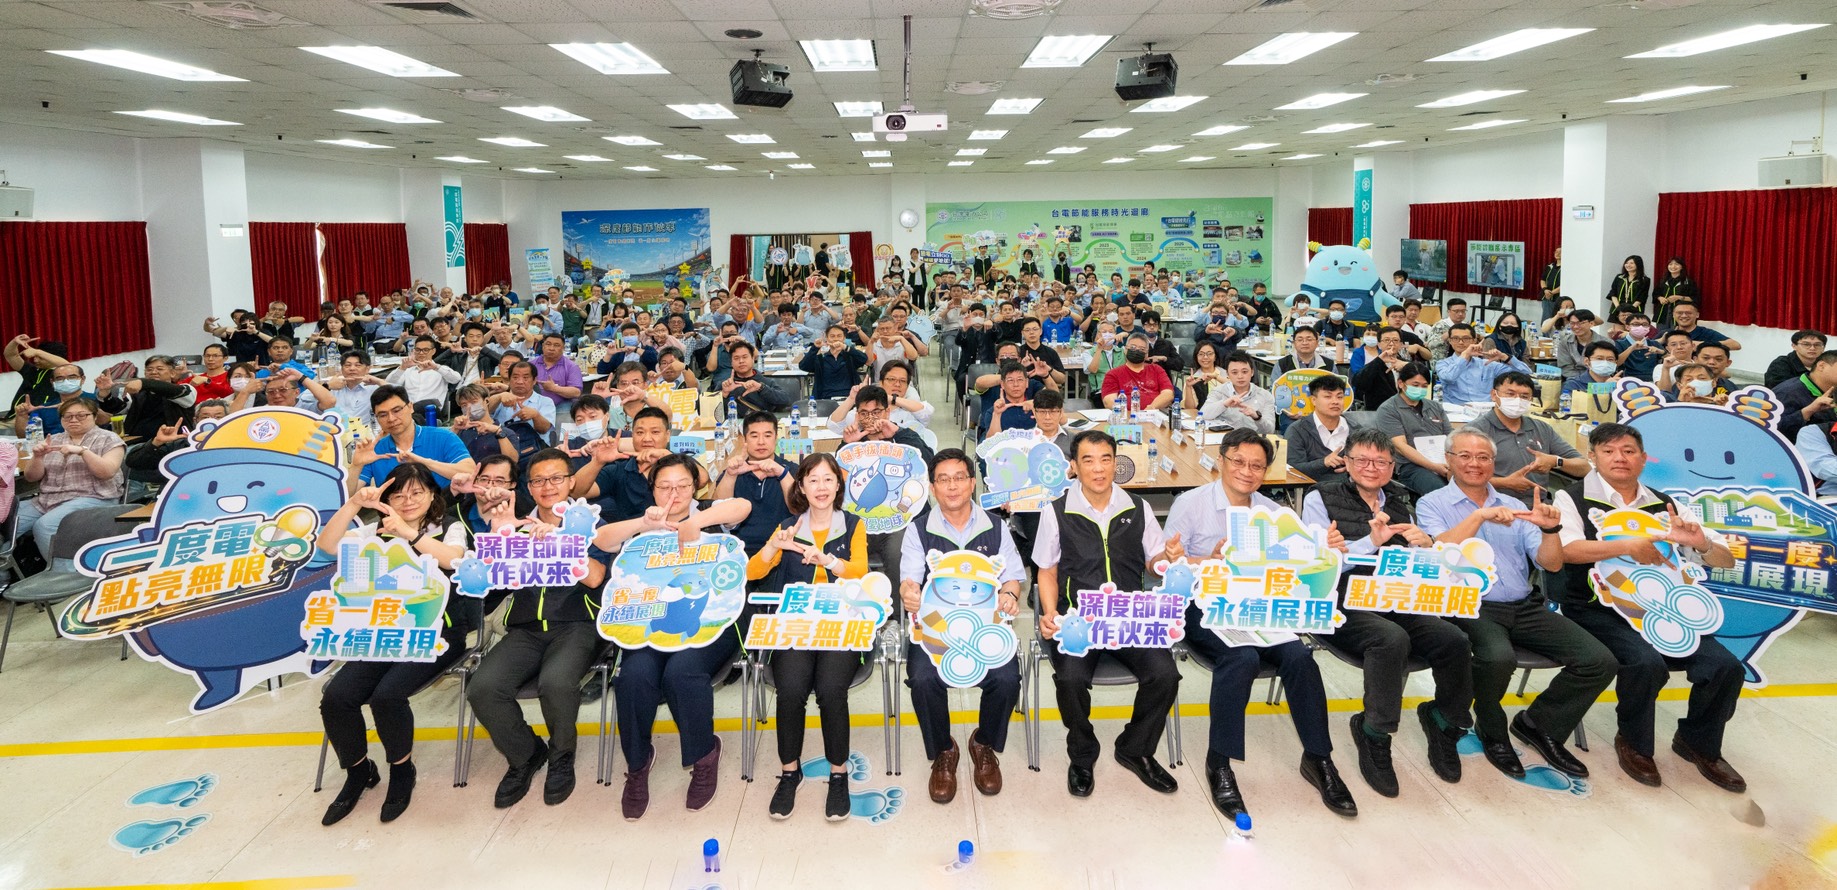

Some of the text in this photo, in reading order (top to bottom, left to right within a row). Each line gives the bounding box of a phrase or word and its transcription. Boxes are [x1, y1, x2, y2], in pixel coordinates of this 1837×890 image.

[840, 444, 904, 463] 隨手拔插頭
[864, 513, 903, 531] 愛地球
[111, 520, 256, 567] 一度電
[477, 535, 585, 559] 深度節能
[625, 537, 680, 556] 一度電
[646, 544, 719, 568] 點亮無限
[491, 561, 571, 585] 作伙來
[1348, 549, 1442, 579] 一度電
[96, 554, 266, 615] 點亮無限
[1200, 565, 1295, 596] 省一度
[1711, 560, 1830, 598] 續展現
[613, 588, 658, 605] 省一度
[751, 586, 841, 614] 一度電
[1079, 593, 1184, 619] 深度節能
[1349, 576, 1481, 616] 點亮無限
[307, 597, 402, 626] 省一度
[603, 603, 667, 623] 永續展現
[1205, 597, 1333, 630] 永續展現
[308, 628, 437, 658] 永續展現
[748, 619, 876, 648] 點亮無限
[1092, 621, 1168, 645] 作伙來
